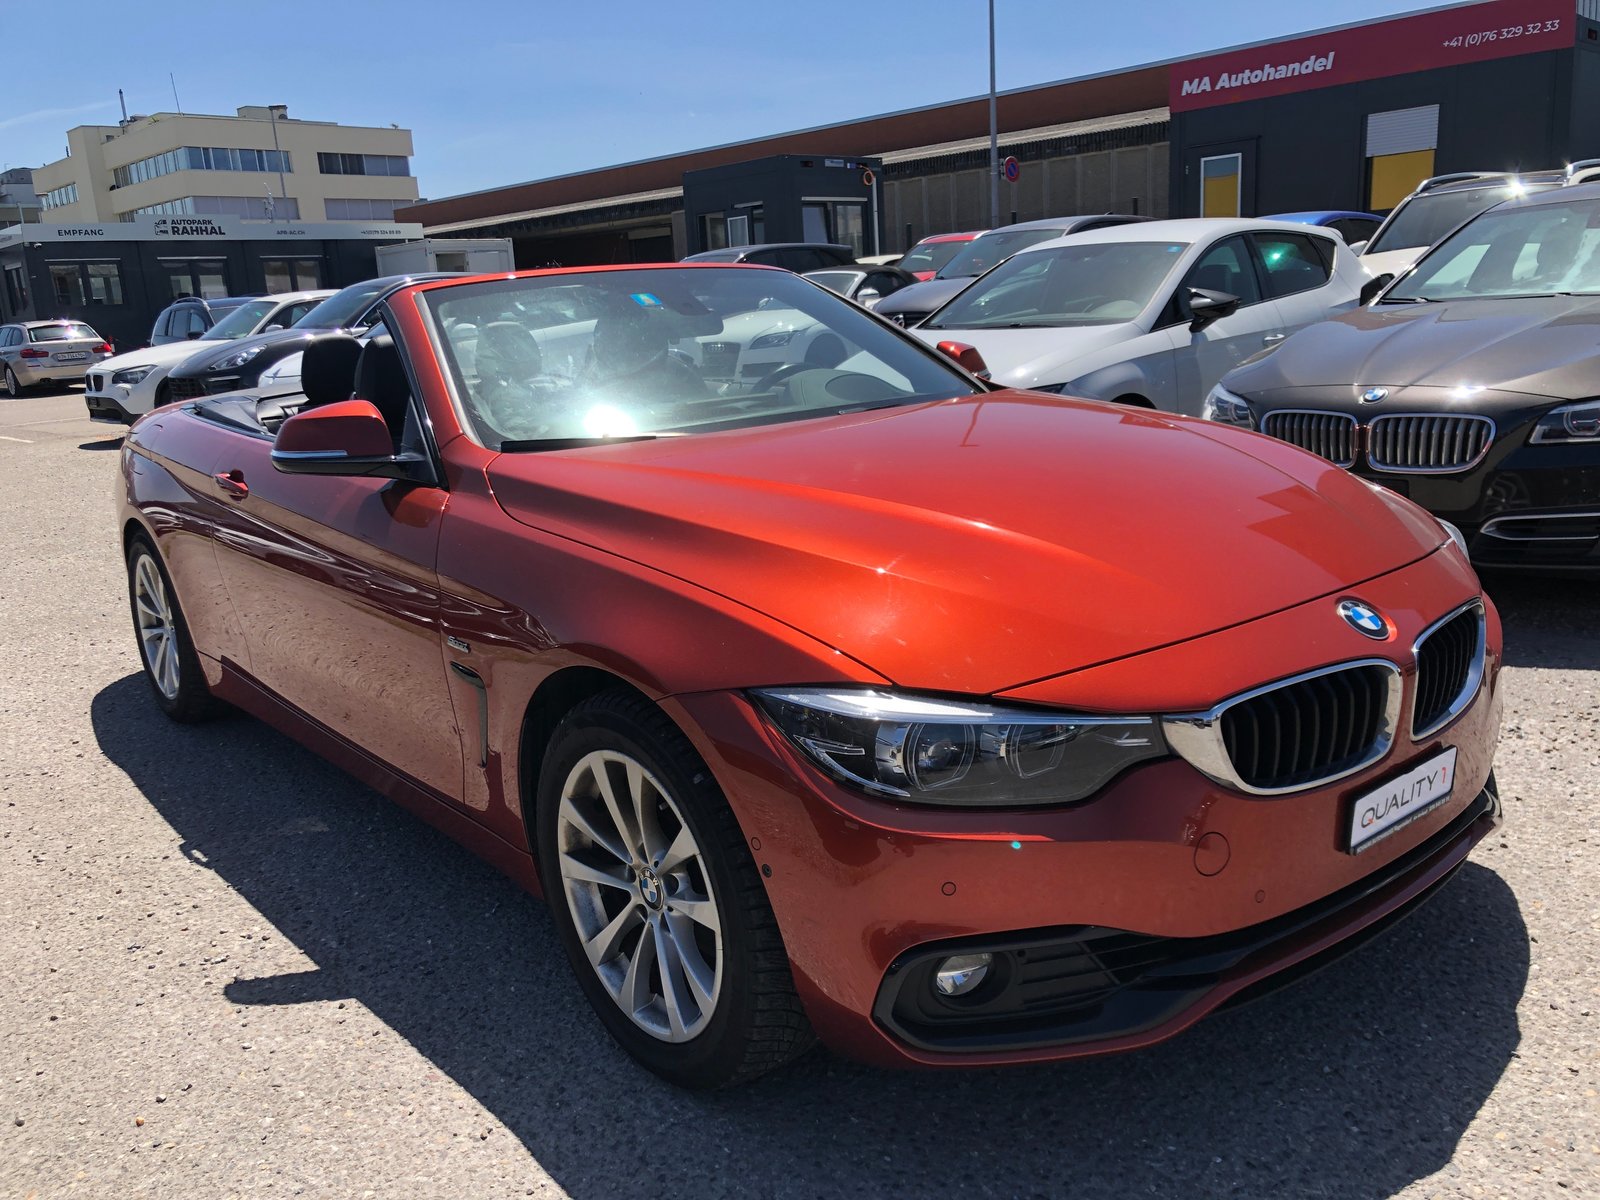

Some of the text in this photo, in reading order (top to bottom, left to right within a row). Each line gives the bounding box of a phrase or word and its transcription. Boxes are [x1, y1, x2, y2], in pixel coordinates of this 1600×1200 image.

[1443, 19, 1560, 48] +41 (0)76 329 32 33
[1180, 51, 1336, 97] MA Autohandel
[57, 228, 104, 237] EMPFANG
[170, 219, 213, 227] AUTOPARK
[171, 226, 226, 236] RAHHAL
[1361, 770, 1439, 829] QUALITY
[1441, 766, 1447, 785] 1
